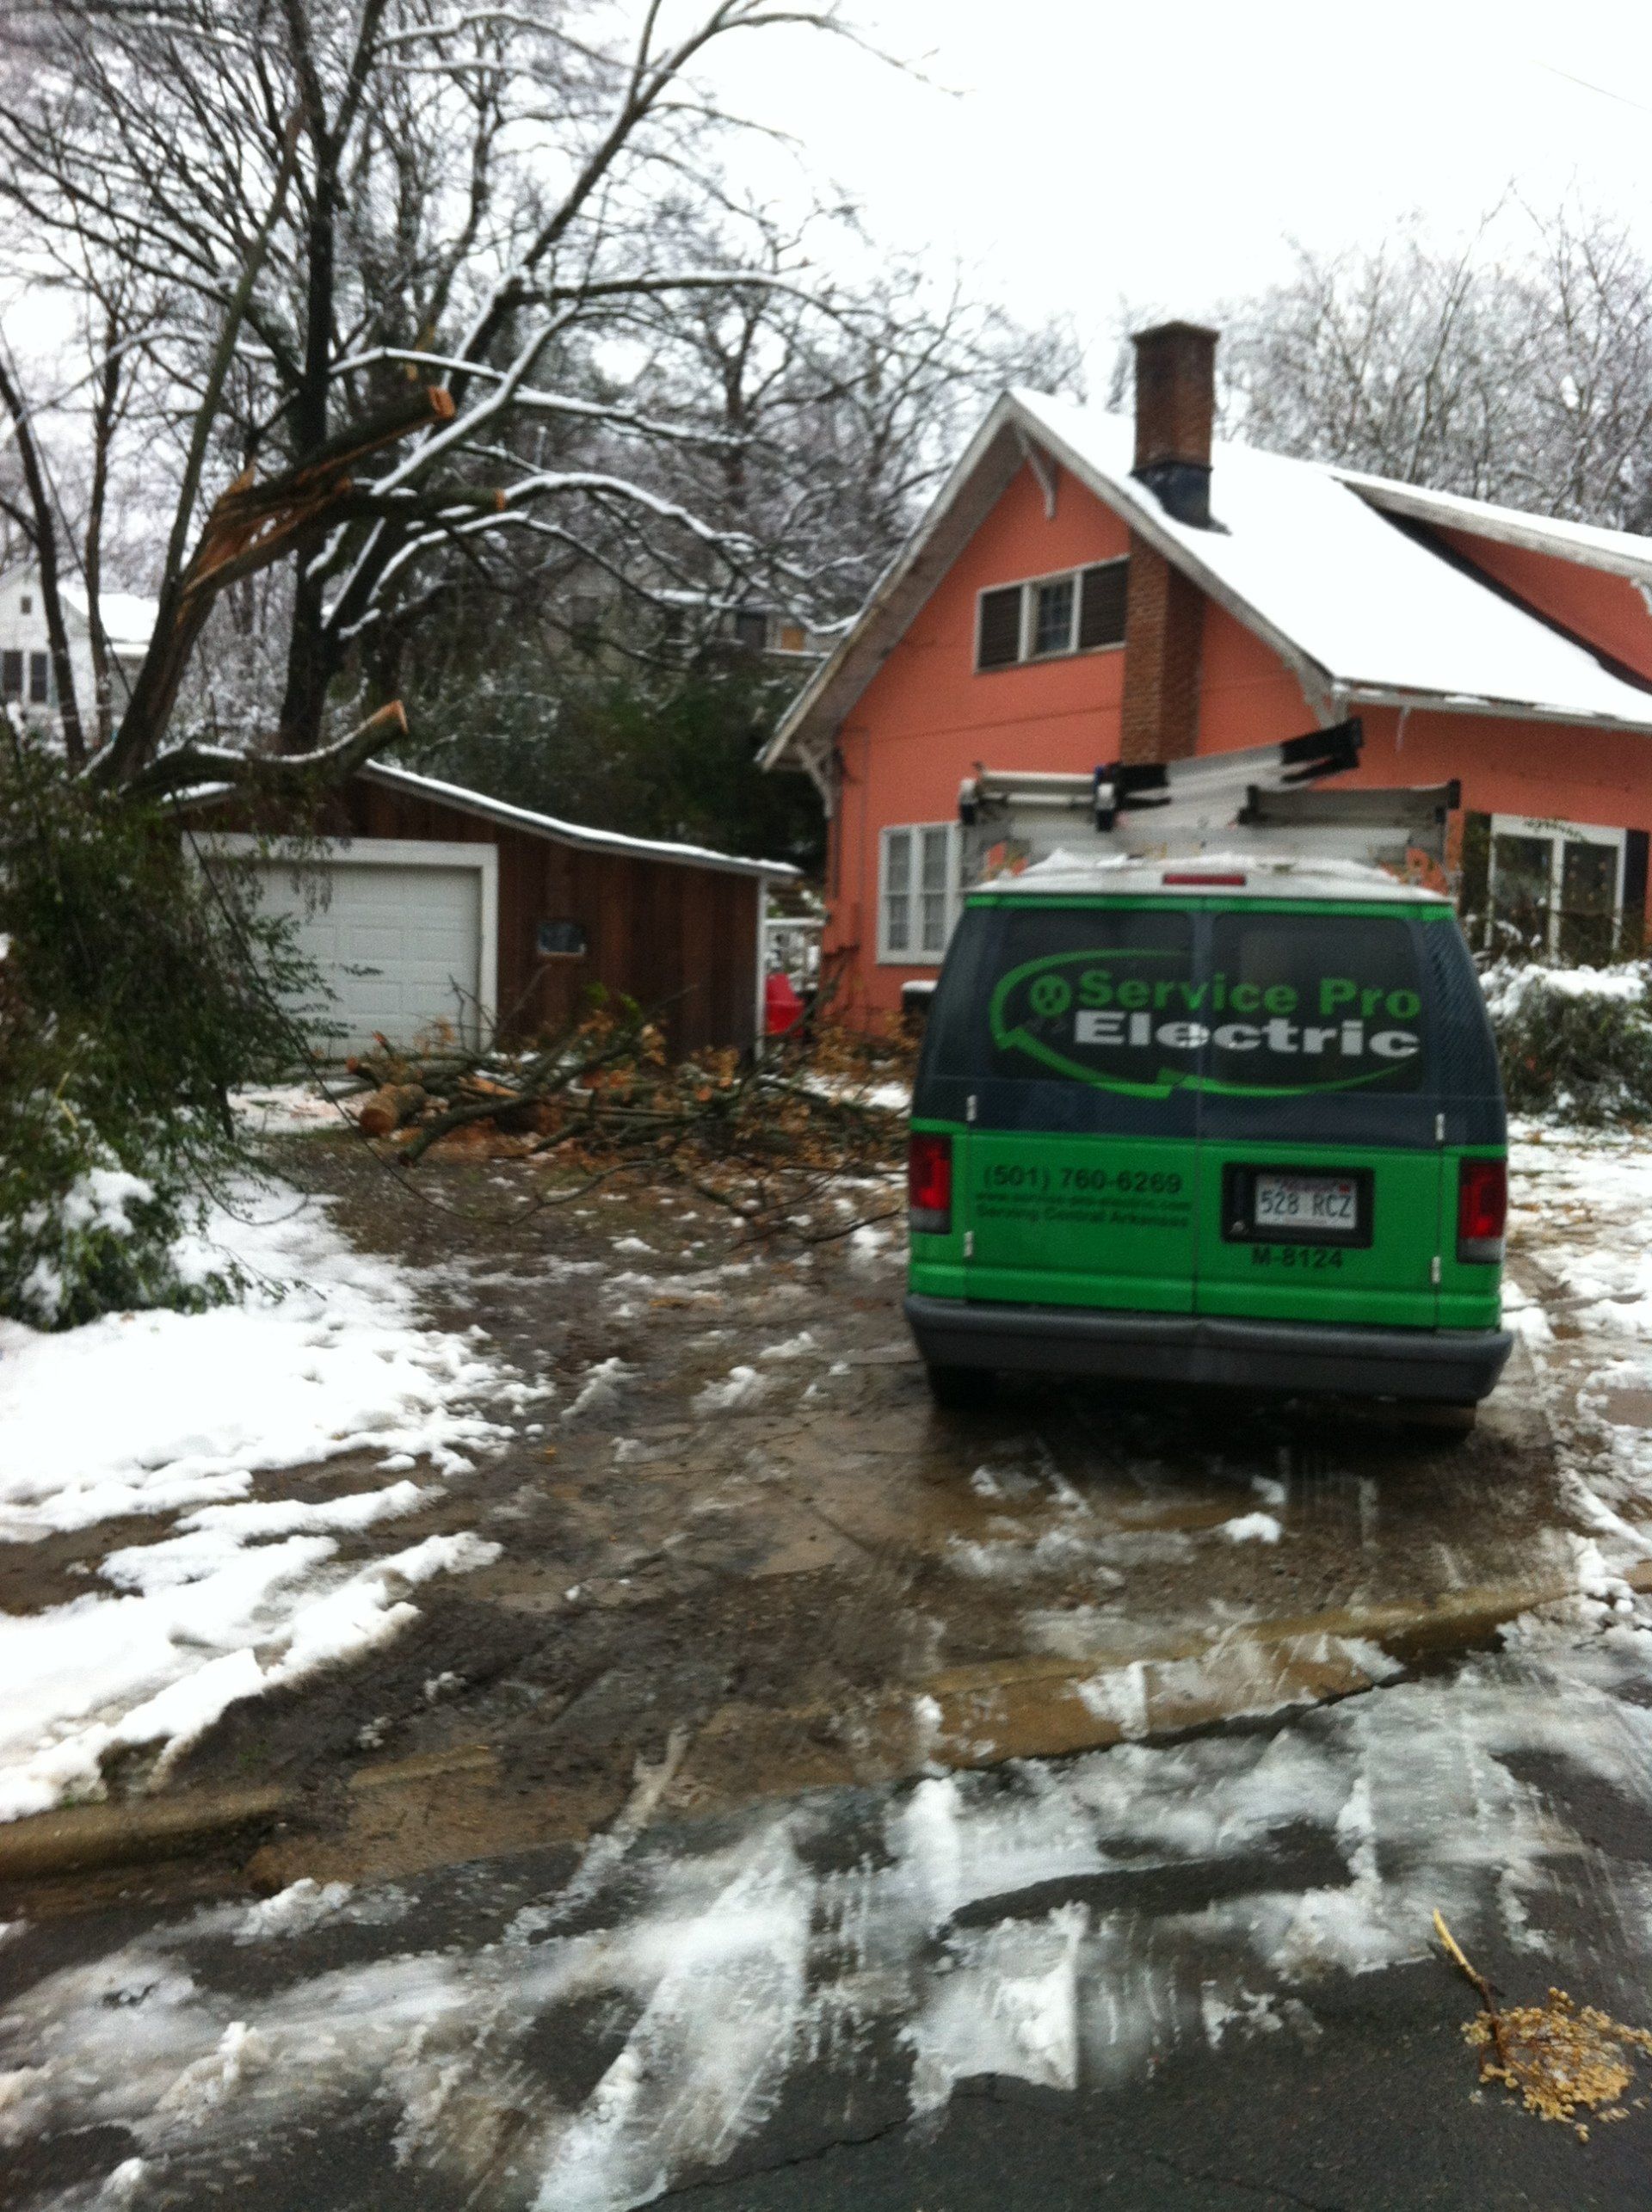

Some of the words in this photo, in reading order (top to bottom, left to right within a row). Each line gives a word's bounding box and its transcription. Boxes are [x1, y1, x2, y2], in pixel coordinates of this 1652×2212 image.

[1078, 970, 1298, 1014] Service
[1319, 977, 1421, 1020] Pro
[1074, 1009, 1420, 1058] Electric
[983, 1164, 1051, 1192] (501)
[1261, 1189, 1300, 1216] 528
[1311, 1192, 1352, 1218] RCZ
[1251, 1246, 1344, 1268] M-8124
